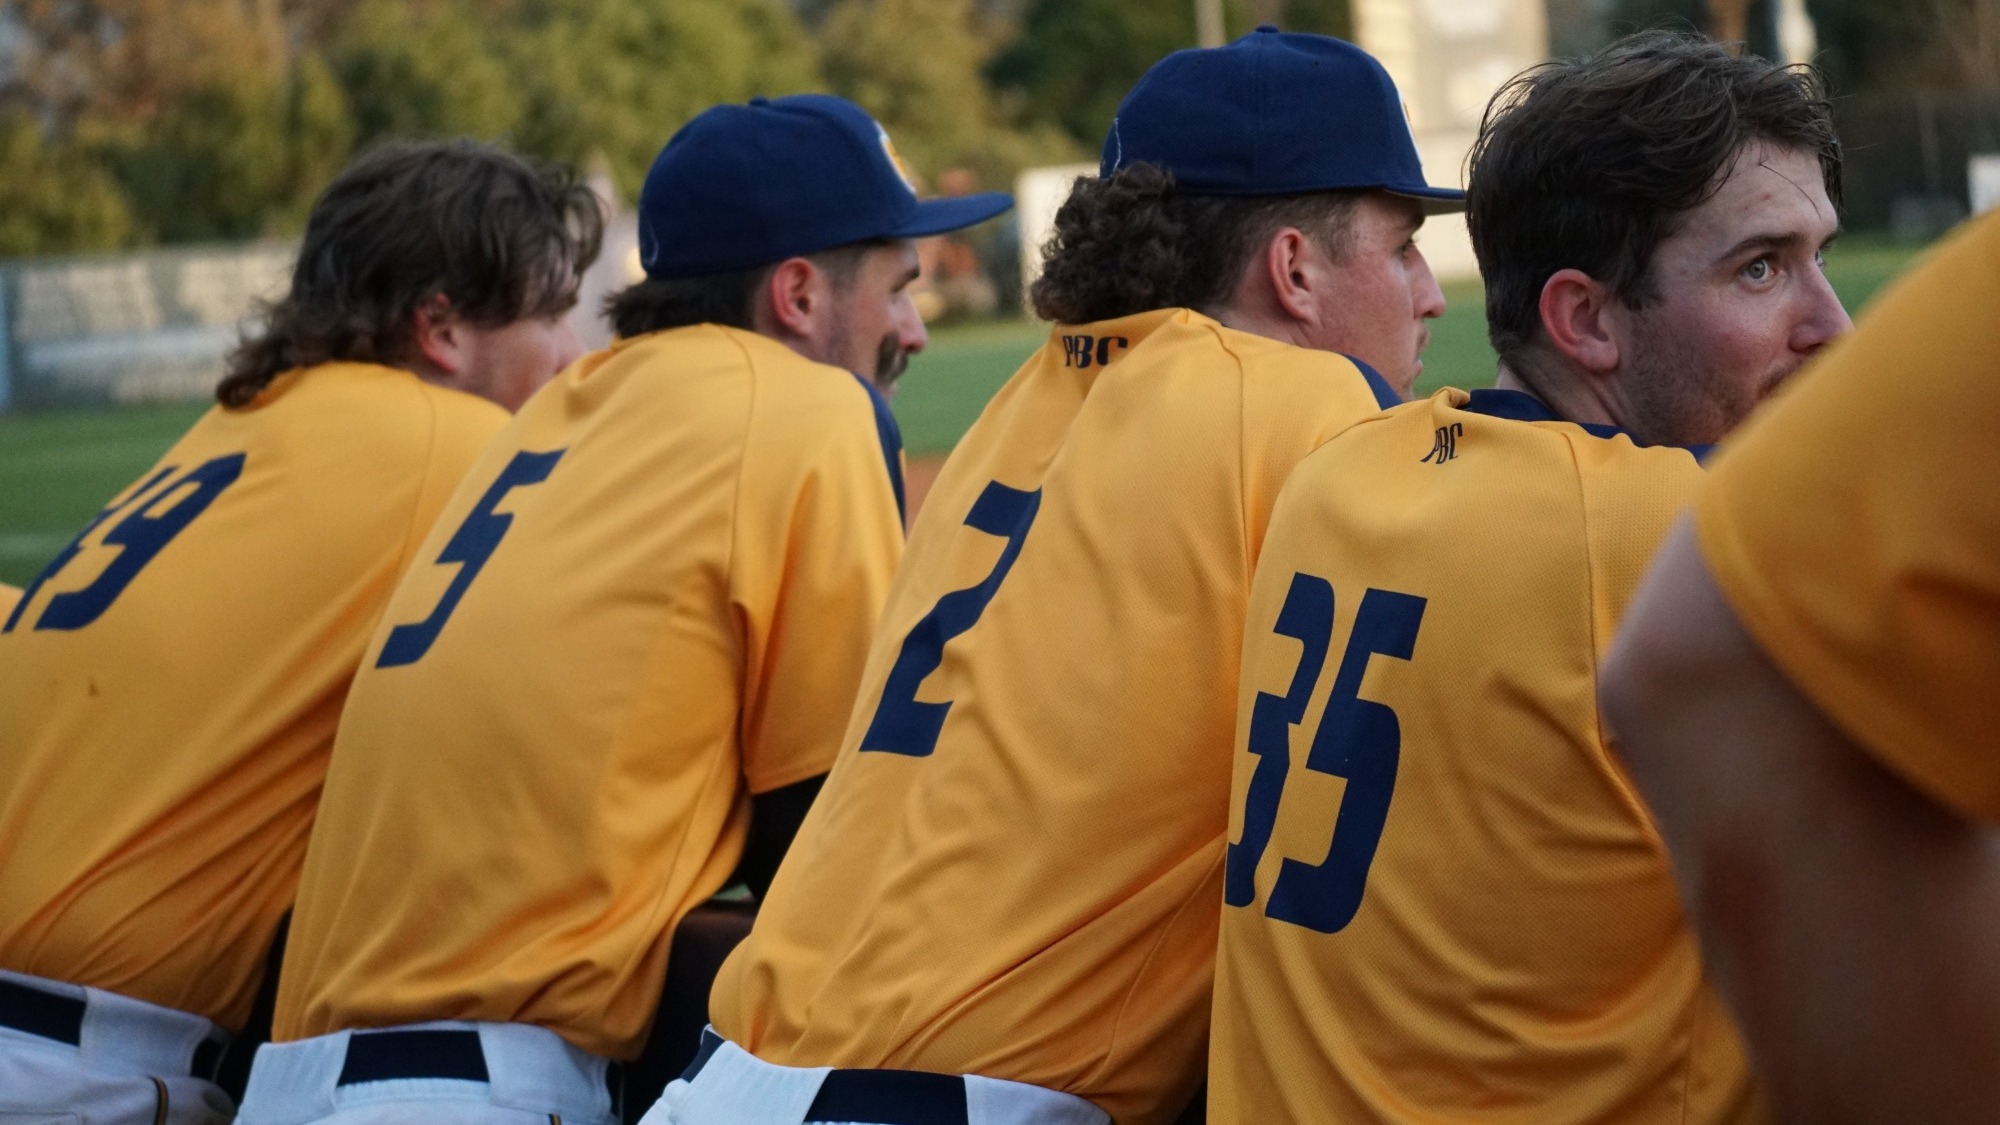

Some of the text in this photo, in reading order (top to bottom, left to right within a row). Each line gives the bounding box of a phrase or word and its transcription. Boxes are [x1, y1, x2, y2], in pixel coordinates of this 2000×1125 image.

[1062, 335, 1128, 368] PBC
[1420, 422, 1463, 464] PBC
[375, 447, 569, 669] 5
[859, 479, 1042, 757] 2
[1225, 571, 1428, 934] 35
